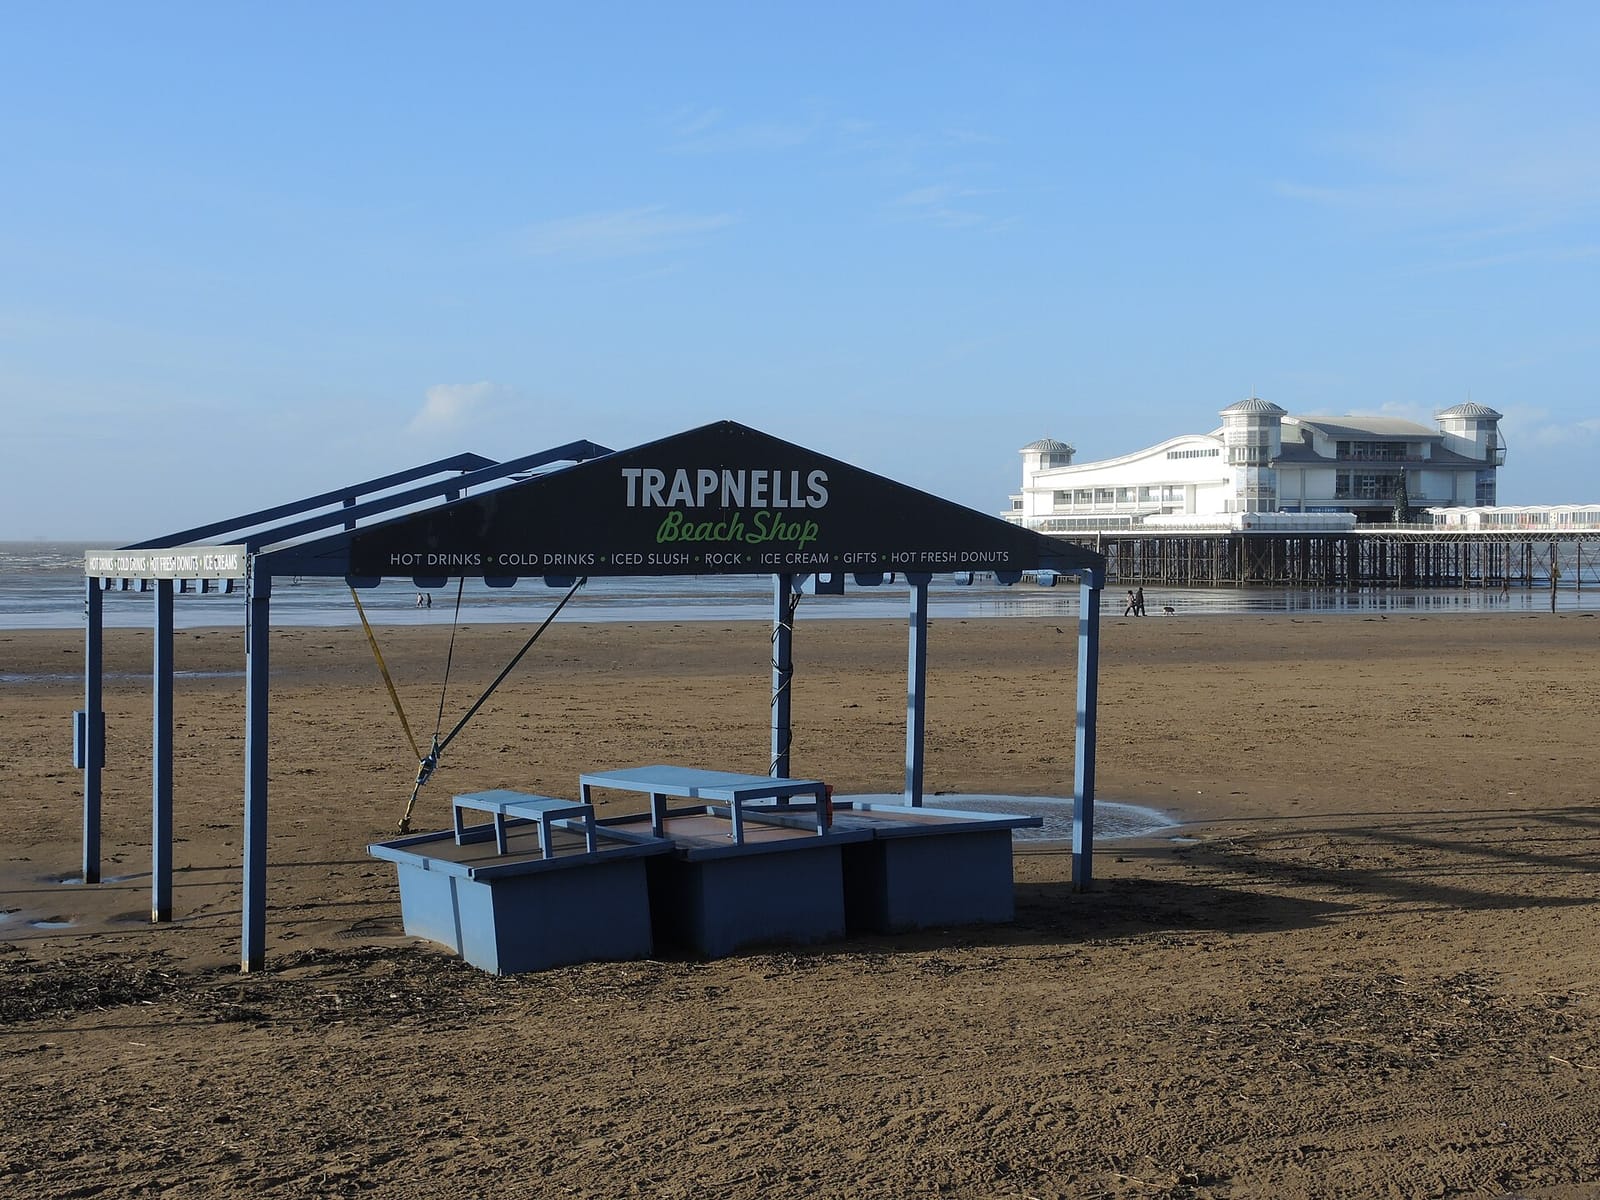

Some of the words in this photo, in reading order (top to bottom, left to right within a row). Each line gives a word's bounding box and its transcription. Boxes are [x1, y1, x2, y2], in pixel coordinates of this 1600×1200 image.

[621, 468, 829, 509] TRAPNELLS
[656, 510, 743, 544] Beach
[745, 510, 819, 550] Shop
[90, 557, 99, 570] HOT
[176, 555, 198, 571] DONUTS
[203, 555, 213, 570] ICE
[214, 554, 238, 570] CREAMS
[390, 553, 422, 565] HOT
[427, 553, 481, 565] DRINKS
[498, 553, 538, 565] COLD
[543, 553, 595, 565] DRINKS
[611, 553, 643, 565] ICED
[648, 553, 690, 565] SLUSH
[704, 553, 742, 565] ROCK
[760, 553, 781, 564] ICE
[785, 553, 830, 564] CREAM
[843, 552, 877, 564] GIFTS
[890, 552, 917, 563] HOT
[920, 552, 957, 563] FRESH
[961, 551, 1010, 563] DONUTS
